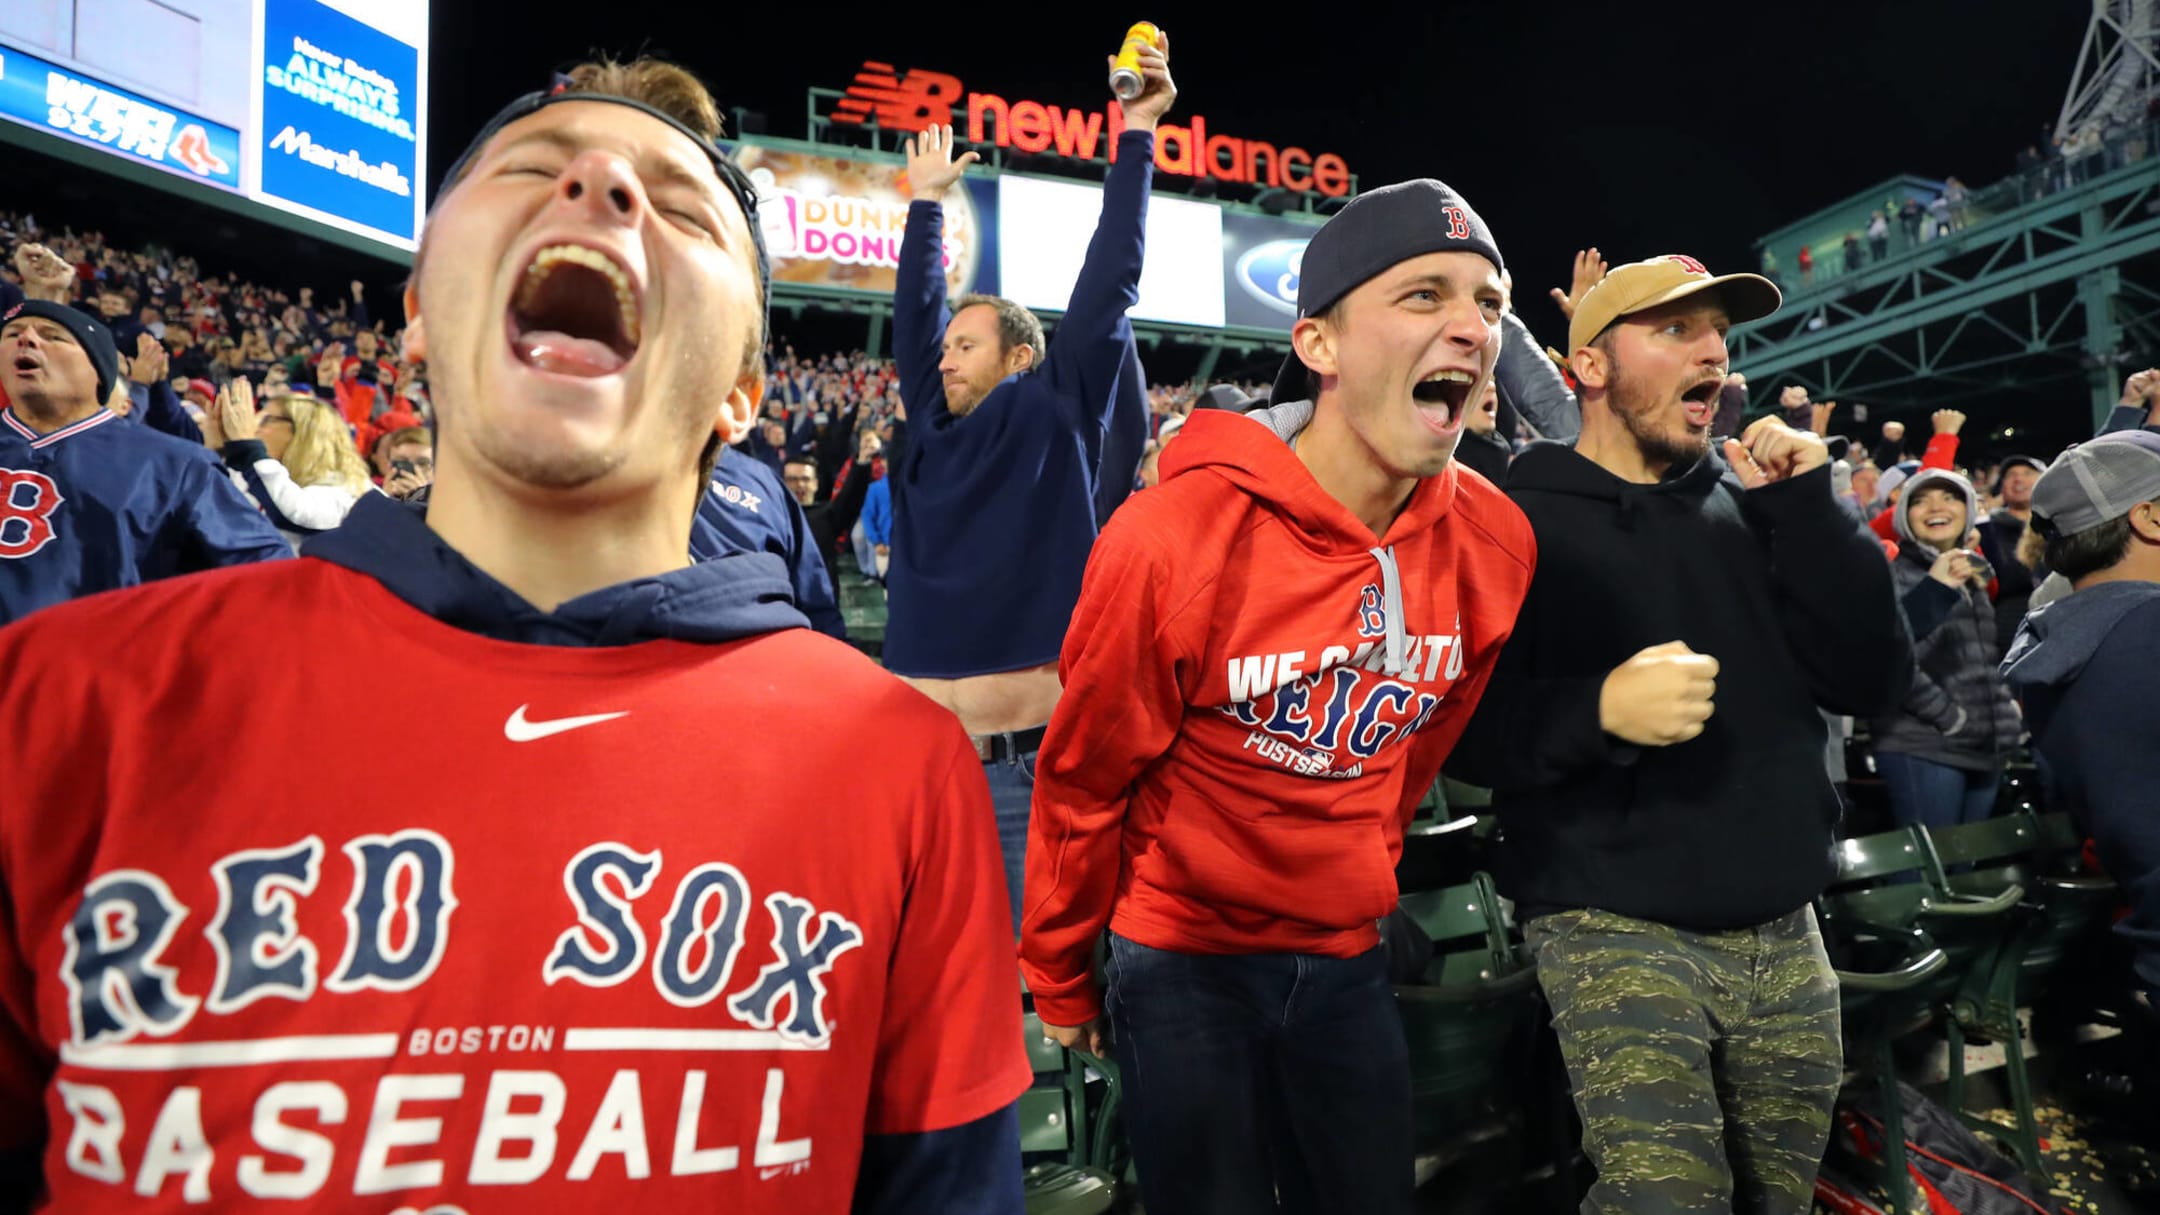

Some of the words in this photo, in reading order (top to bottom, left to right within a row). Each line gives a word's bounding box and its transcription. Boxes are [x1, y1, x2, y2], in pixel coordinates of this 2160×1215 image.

[286, 52, 400, 116] ALWAYS
[967, 92, 1103, 160] new
[269, 125, 410, 197] Marshalls
[1442, 206, 1470, 239] B
[1228, 650, 1305, 703] WE
[1423, 634, 1464, 682] TO
[60, 828, 459, 1047] RED
[543, 841, 863, 1049] SOX
[409, 1026, 556, 1056] BOSTON
[56, 1068, 813, 1204] BASEBALL
